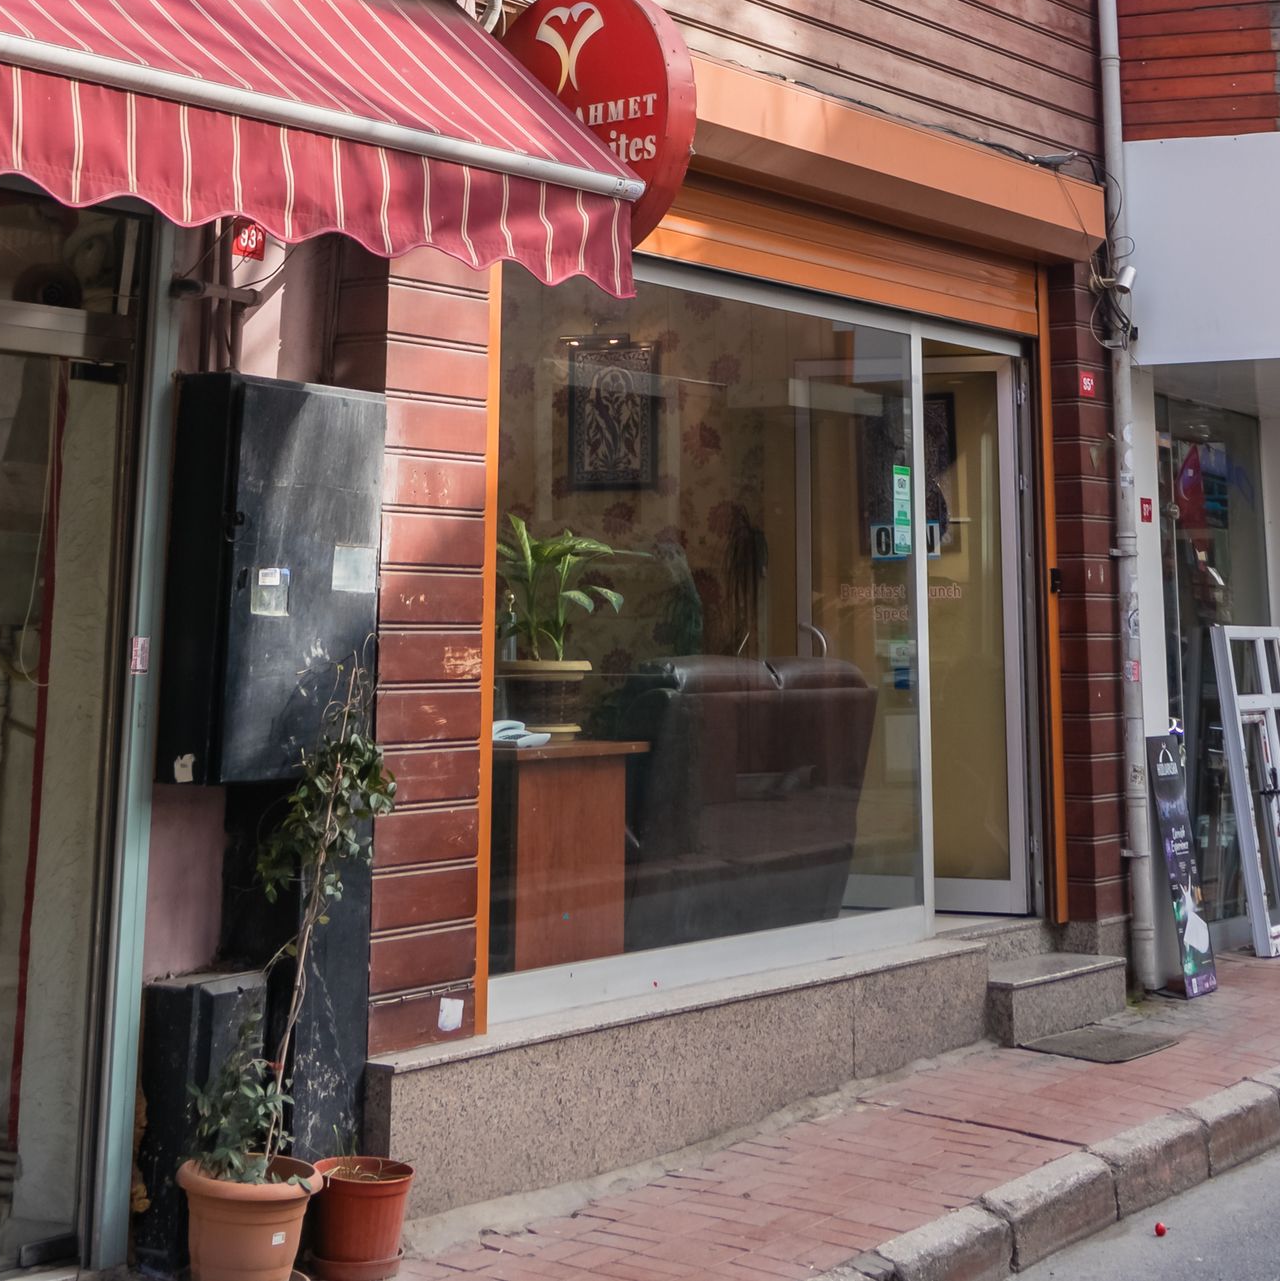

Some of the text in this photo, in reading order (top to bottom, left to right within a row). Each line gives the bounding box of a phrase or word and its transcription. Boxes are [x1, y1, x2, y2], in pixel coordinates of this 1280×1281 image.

[609, 130, 657, 163] ites
[840, 582, 961, 600] Breakfast unch
